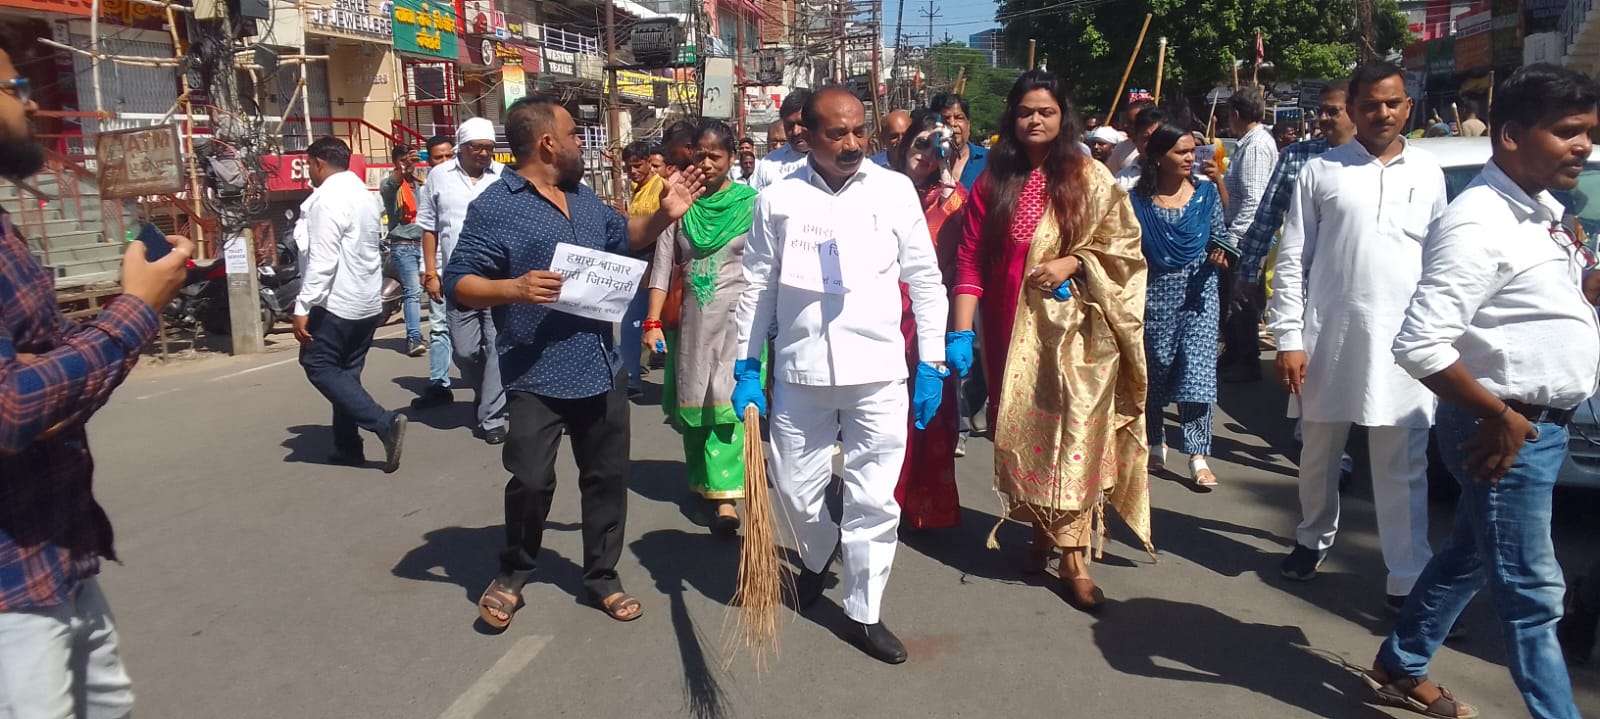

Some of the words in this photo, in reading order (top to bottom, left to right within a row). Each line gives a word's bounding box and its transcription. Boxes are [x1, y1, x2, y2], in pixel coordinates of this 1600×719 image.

[332, 9, 393, 36] JEWELLERS
[567, 253, 595, 267] हमारा
[600, 261, 631, 275] बाजार
[586, 271, 633, 291] जिम्मेदारी
